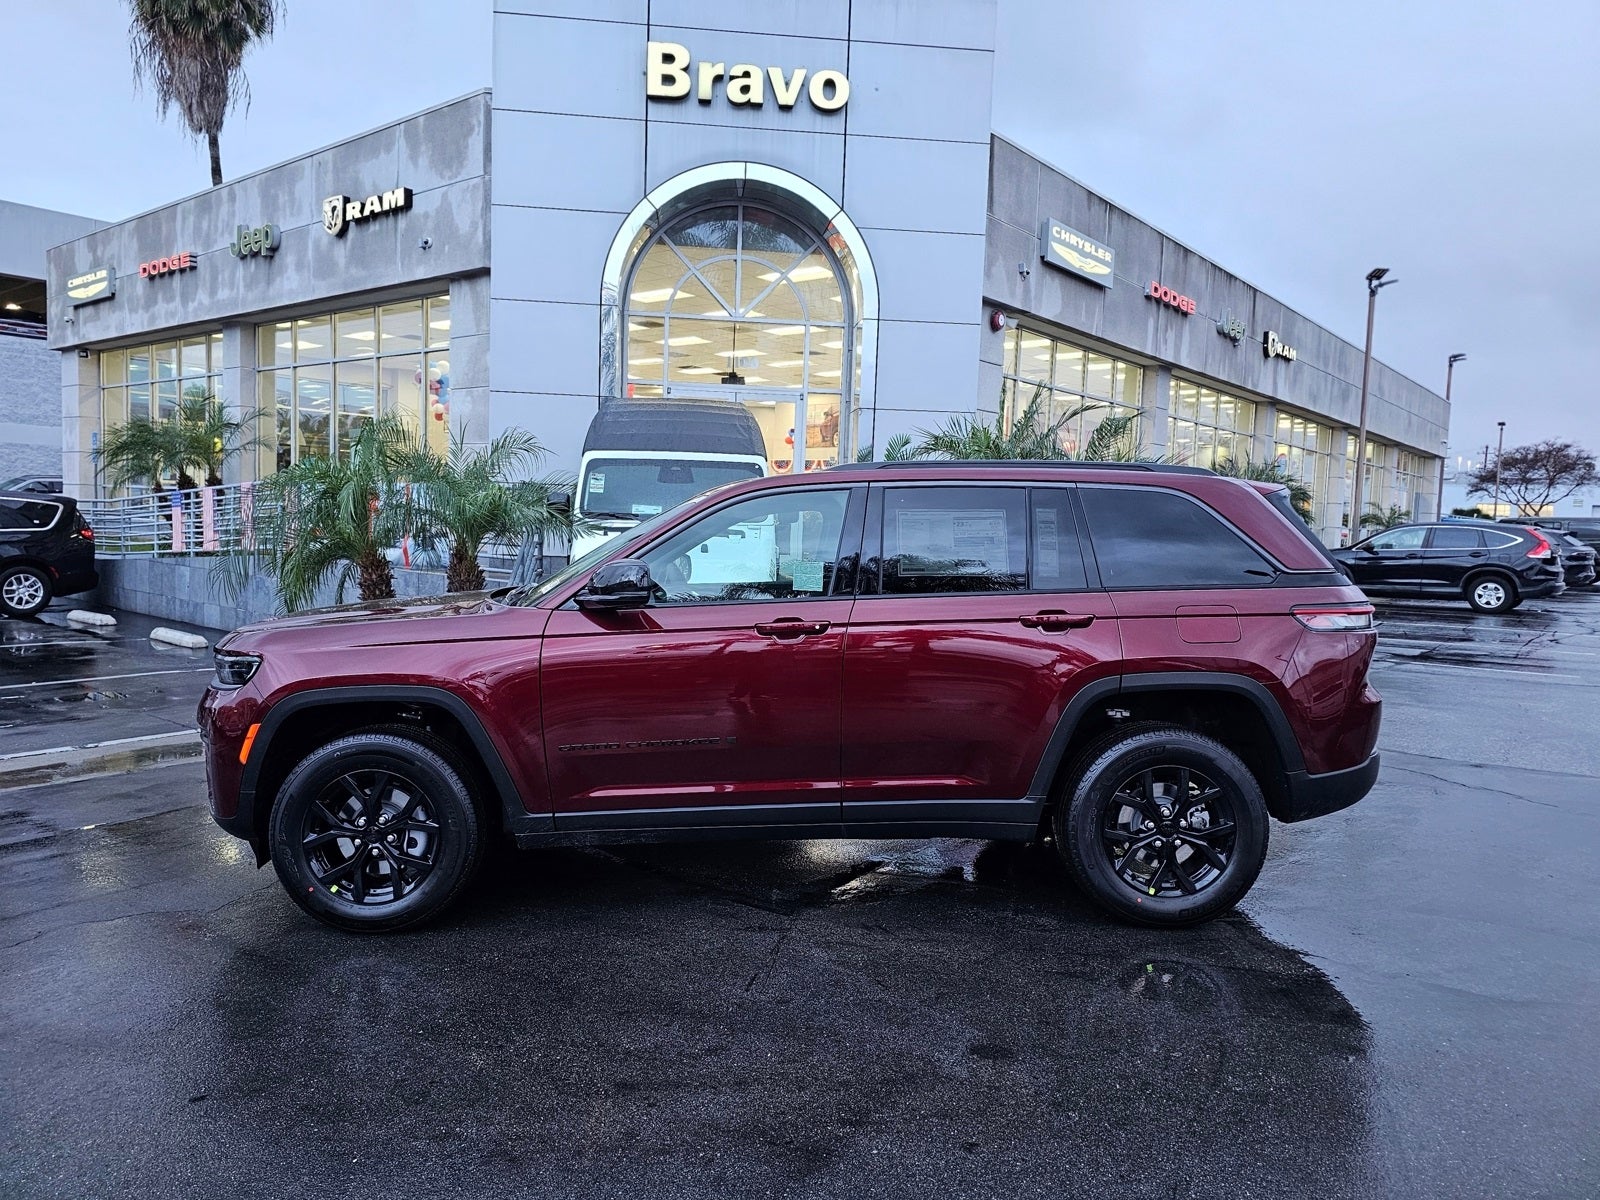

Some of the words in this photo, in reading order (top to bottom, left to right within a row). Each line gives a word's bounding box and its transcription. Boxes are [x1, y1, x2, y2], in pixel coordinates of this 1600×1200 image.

[646, 41, 850, 111] Bravo
[345, 187, 406, 221] RAM
[230, 222, 274, 257] Jeep
[1052, 226, 1113, 263] CHRYSLER
[67, 269, 108, 288] CHRYSLER
[139, 252, 191, 279] DODGE
[1151, 280, 1197, 315] DODGE
[1276, 341, 1297, 361] RAM
[625, 737, 721, 749] CHEROKEE
